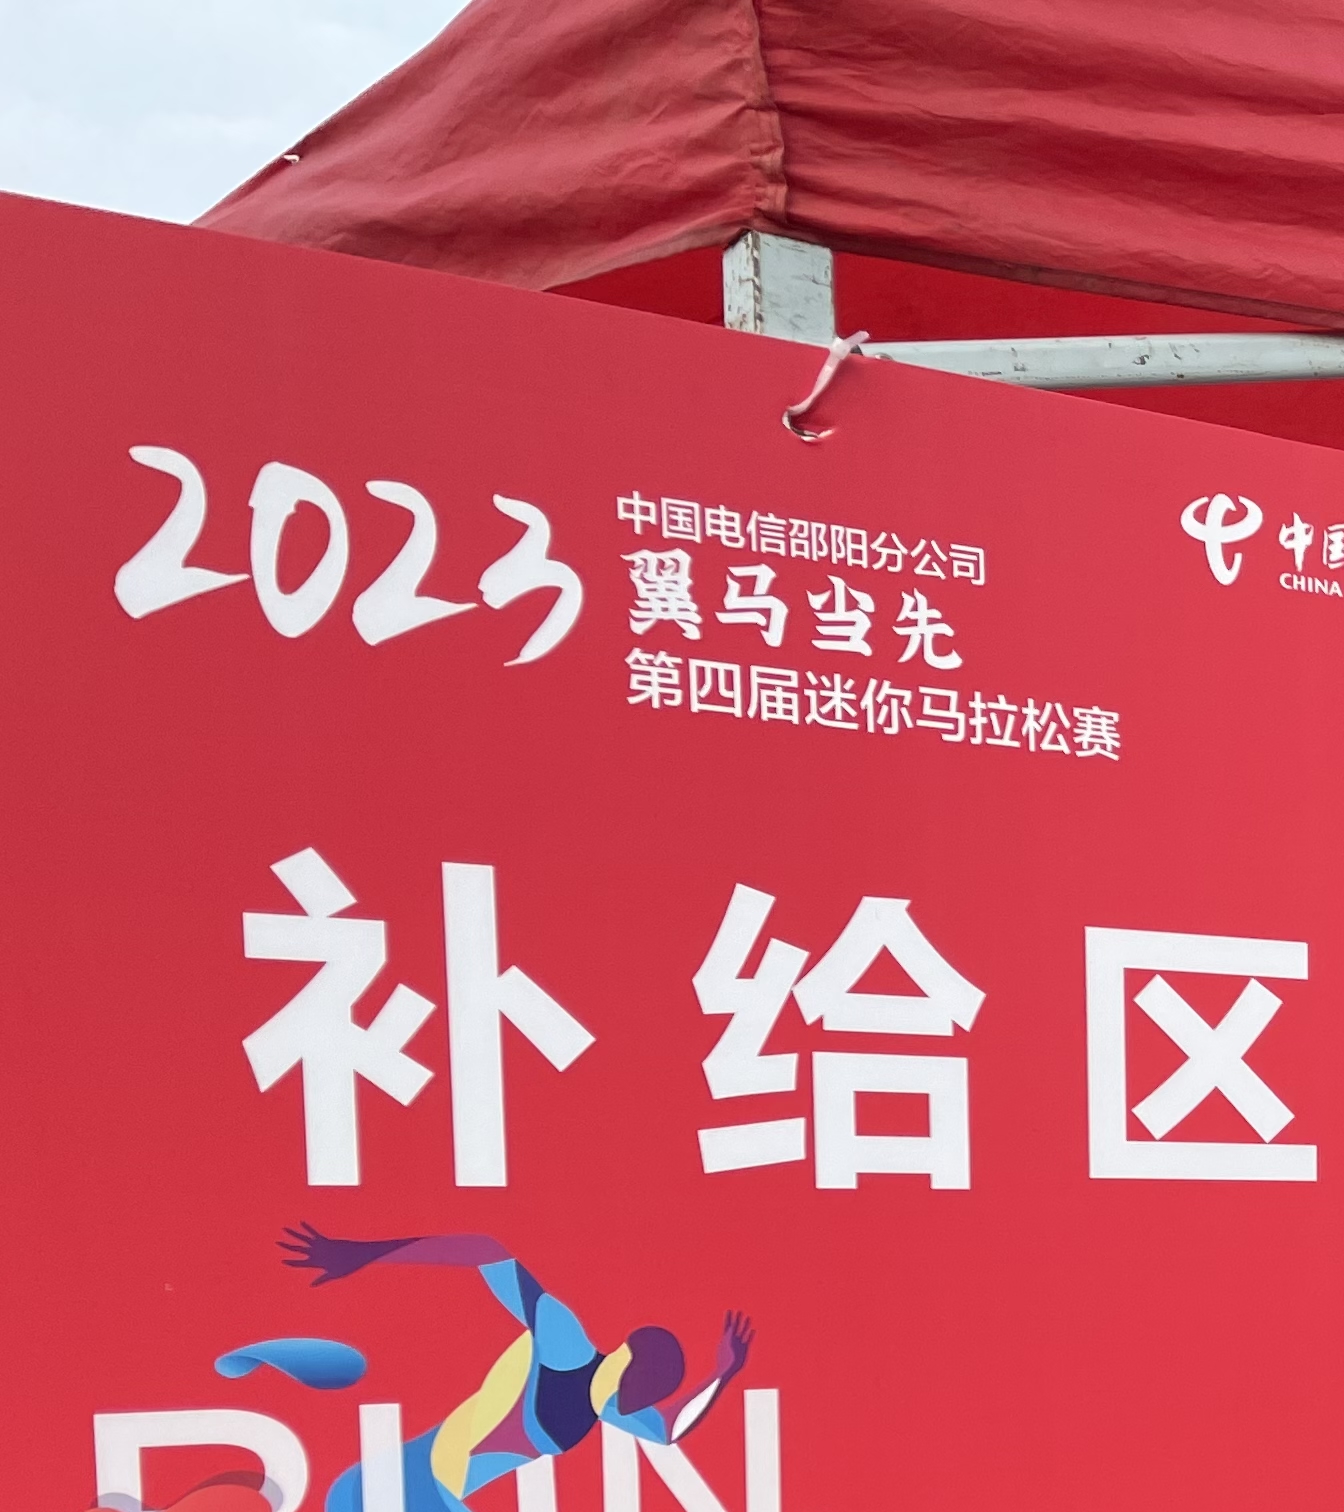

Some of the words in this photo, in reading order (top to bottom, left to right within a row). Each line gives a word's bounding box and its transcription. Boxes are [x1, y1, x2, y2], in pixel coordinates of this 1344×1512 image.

[114, 445, 583, 666] 2023
[616, 490, 986, 586] 中国电信邵阳分公司
[1279, 572, 1343, 597] CHINA
[620, 548, 962, 669] 翼马当先
[624, 647, 1122, 761] 第四届迷你马拉松赛
[242, 846, 1318, 1189] 补给区
